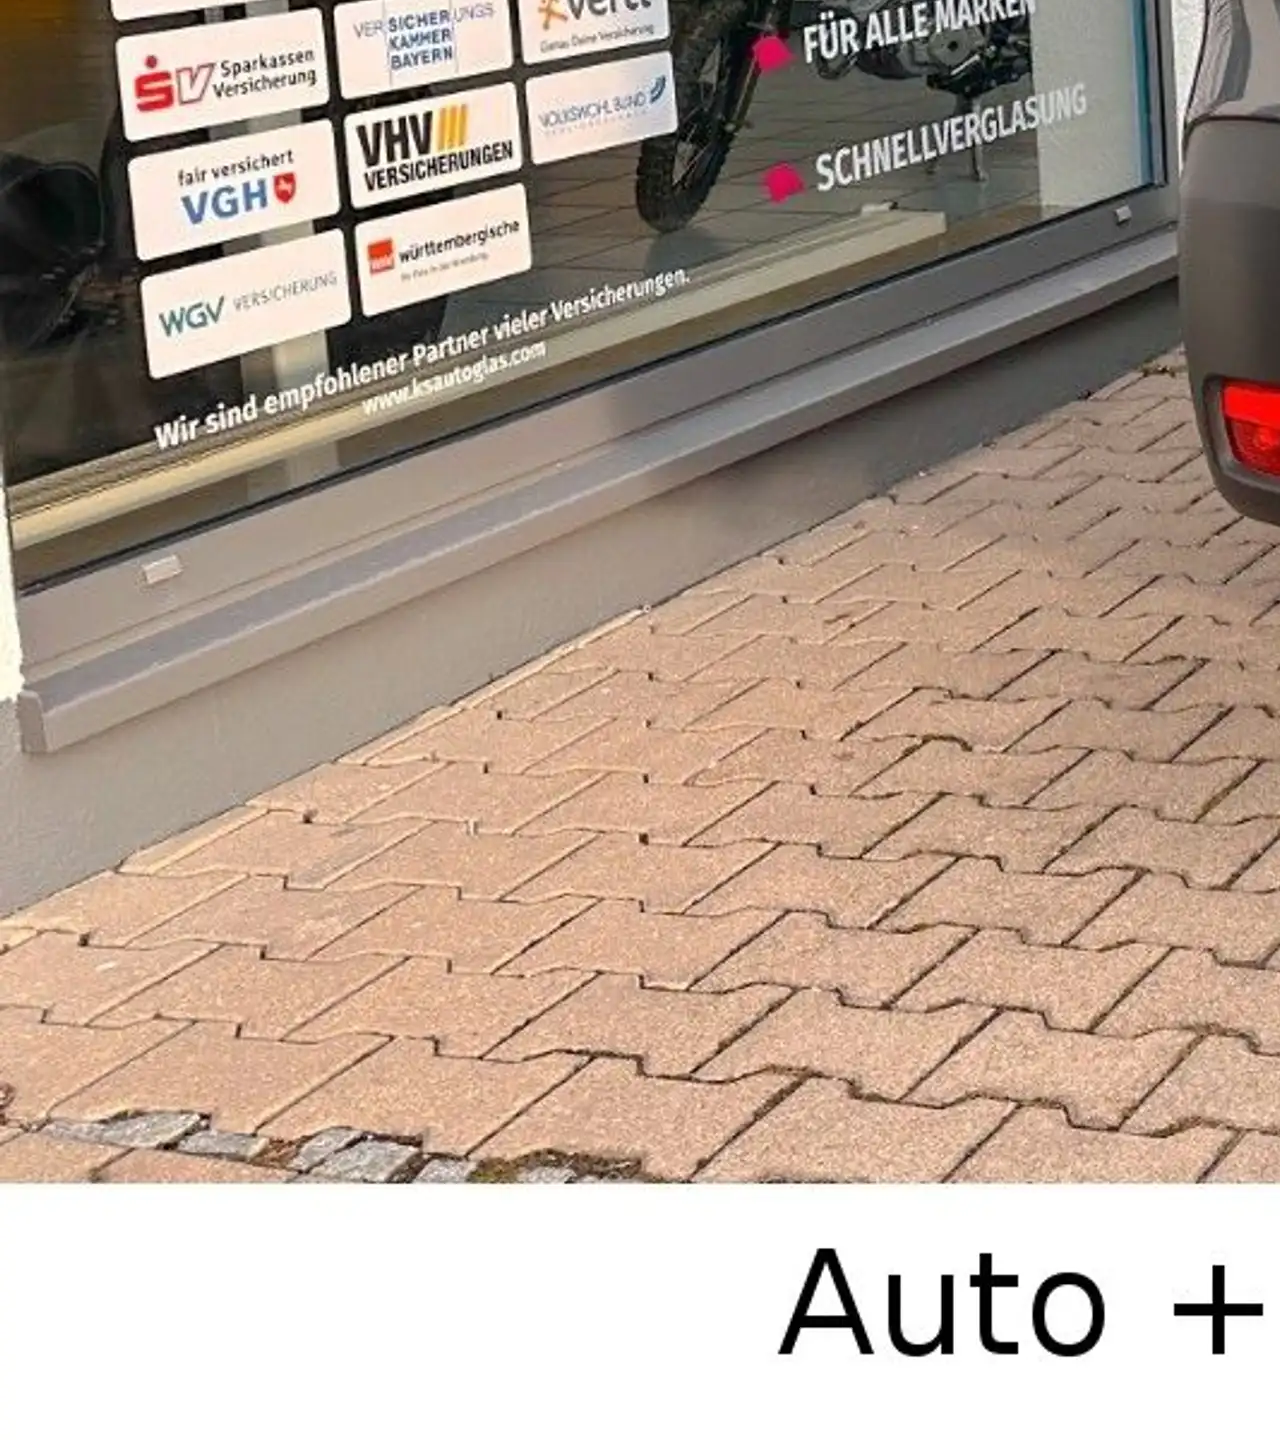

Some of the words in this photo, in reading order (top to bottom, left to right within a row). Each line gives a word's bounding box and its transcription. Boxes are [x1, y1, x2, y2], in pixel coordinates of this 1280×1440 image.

[388, 27, 451, 50] KAMMER
[803, 10, 860, 64] FÜR
[864, 0, 930, 51] ALLE
[212, 68, 318, 101] Versicherung
[219, 47, 316, 79] Sparkassen
[390, 46, 454, 71] BAYERN
[355, 109, 436, 168] VHV
[815, 82, 1088, 193] SCHNELLVERGLASUNG
[177, 166, 207, 188] fair
[210, 149, 295, 181] versichert
[363, 139, 514, 192] VERSICHERUNGEN
[180, 176, 268, 227] VGH
[398, 217, 521, 265] württembergische
[157, 293, 227, 339] WGV
[232, 269, 339, 313] VERSICHERUNG
[153, 415, 200, 452] Wir
[204, 392, 259, 434] sind
[263, 348, 410, 413] empfohlener
[411, 323, 490, 366] Partner
[493, 302, 548, 340] vieler
[547, 266, 692, 324] Versicherungen.
[361, 340, 548, 416] www.ksautoglas.com
